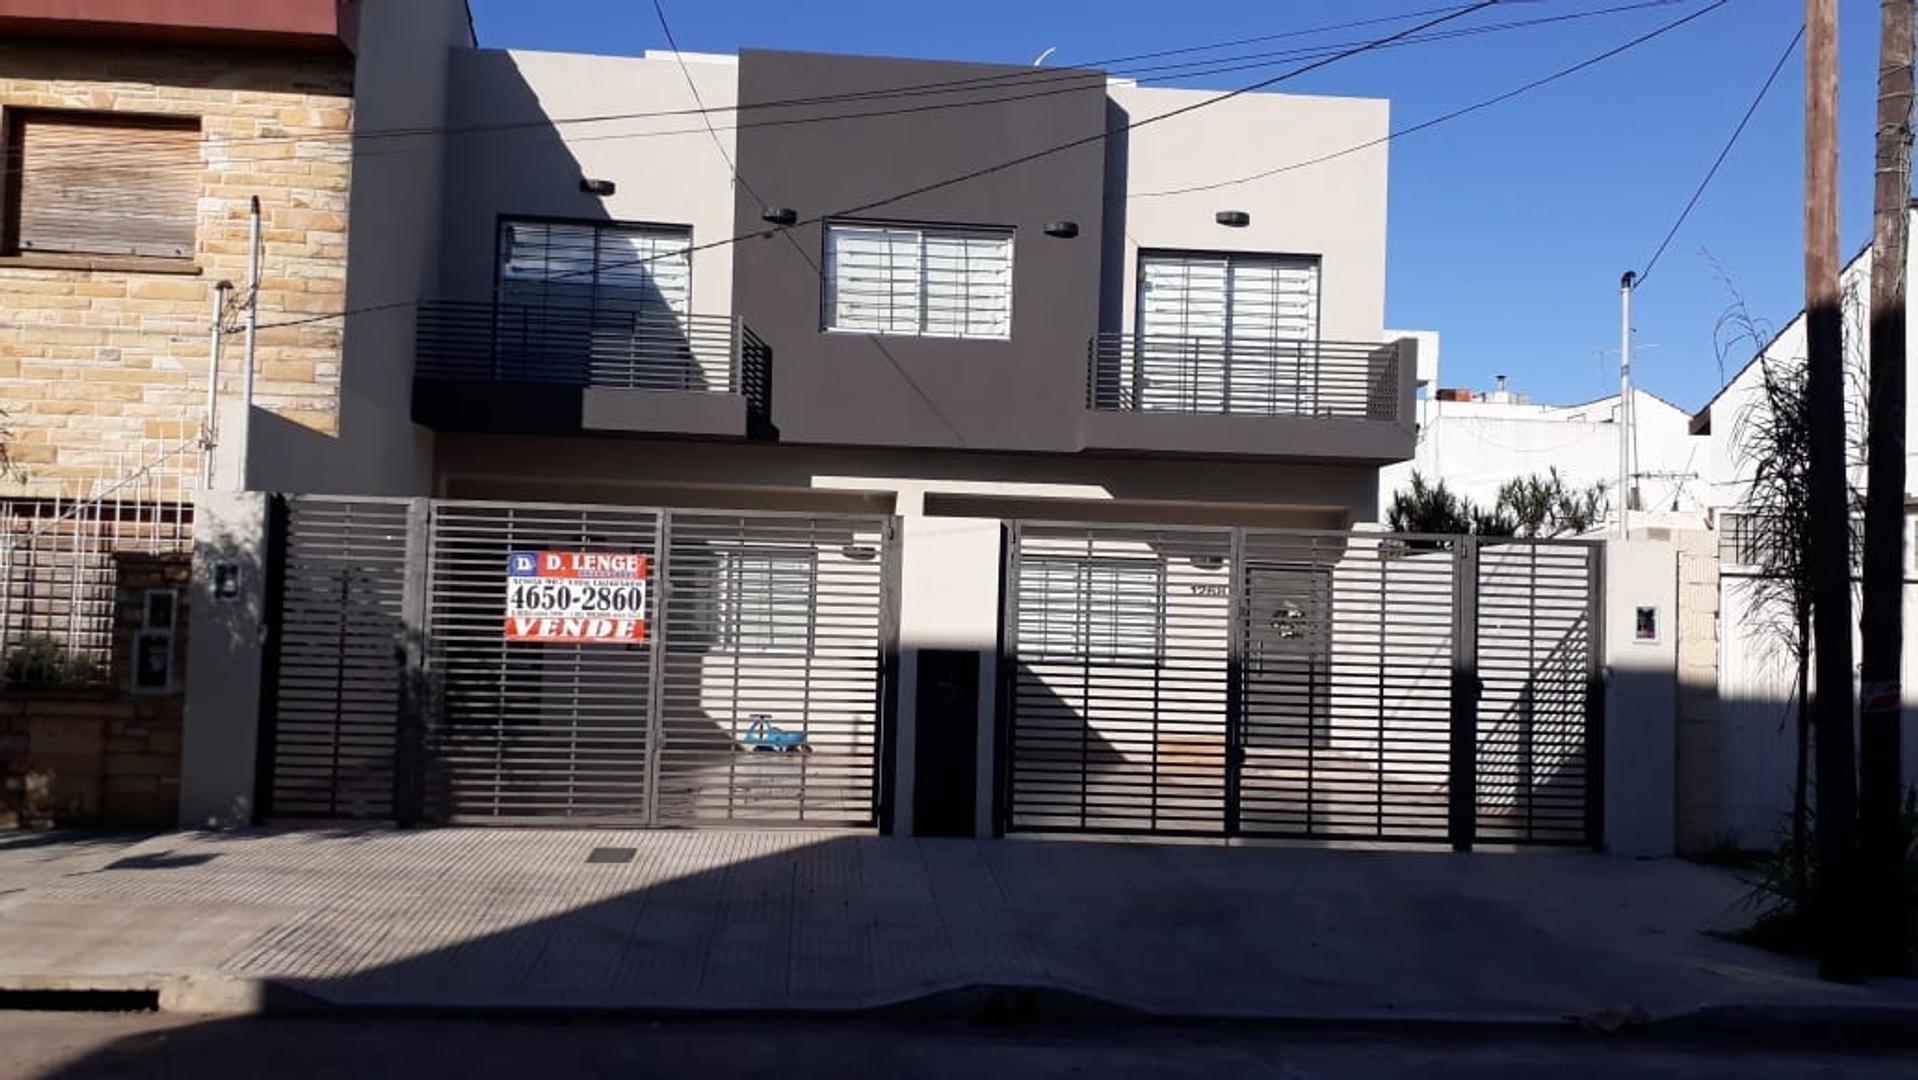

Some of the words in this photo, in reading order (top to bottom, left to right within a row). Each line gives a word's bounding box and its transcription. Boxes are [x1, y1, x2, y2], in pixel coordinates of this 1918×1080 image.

[545, 554, 566, 571] D.
[572, 555, 638, 572] LENGE
[510, 585, 643, 611] 4650-2860
[515, 618, 635, 638] VENDE
